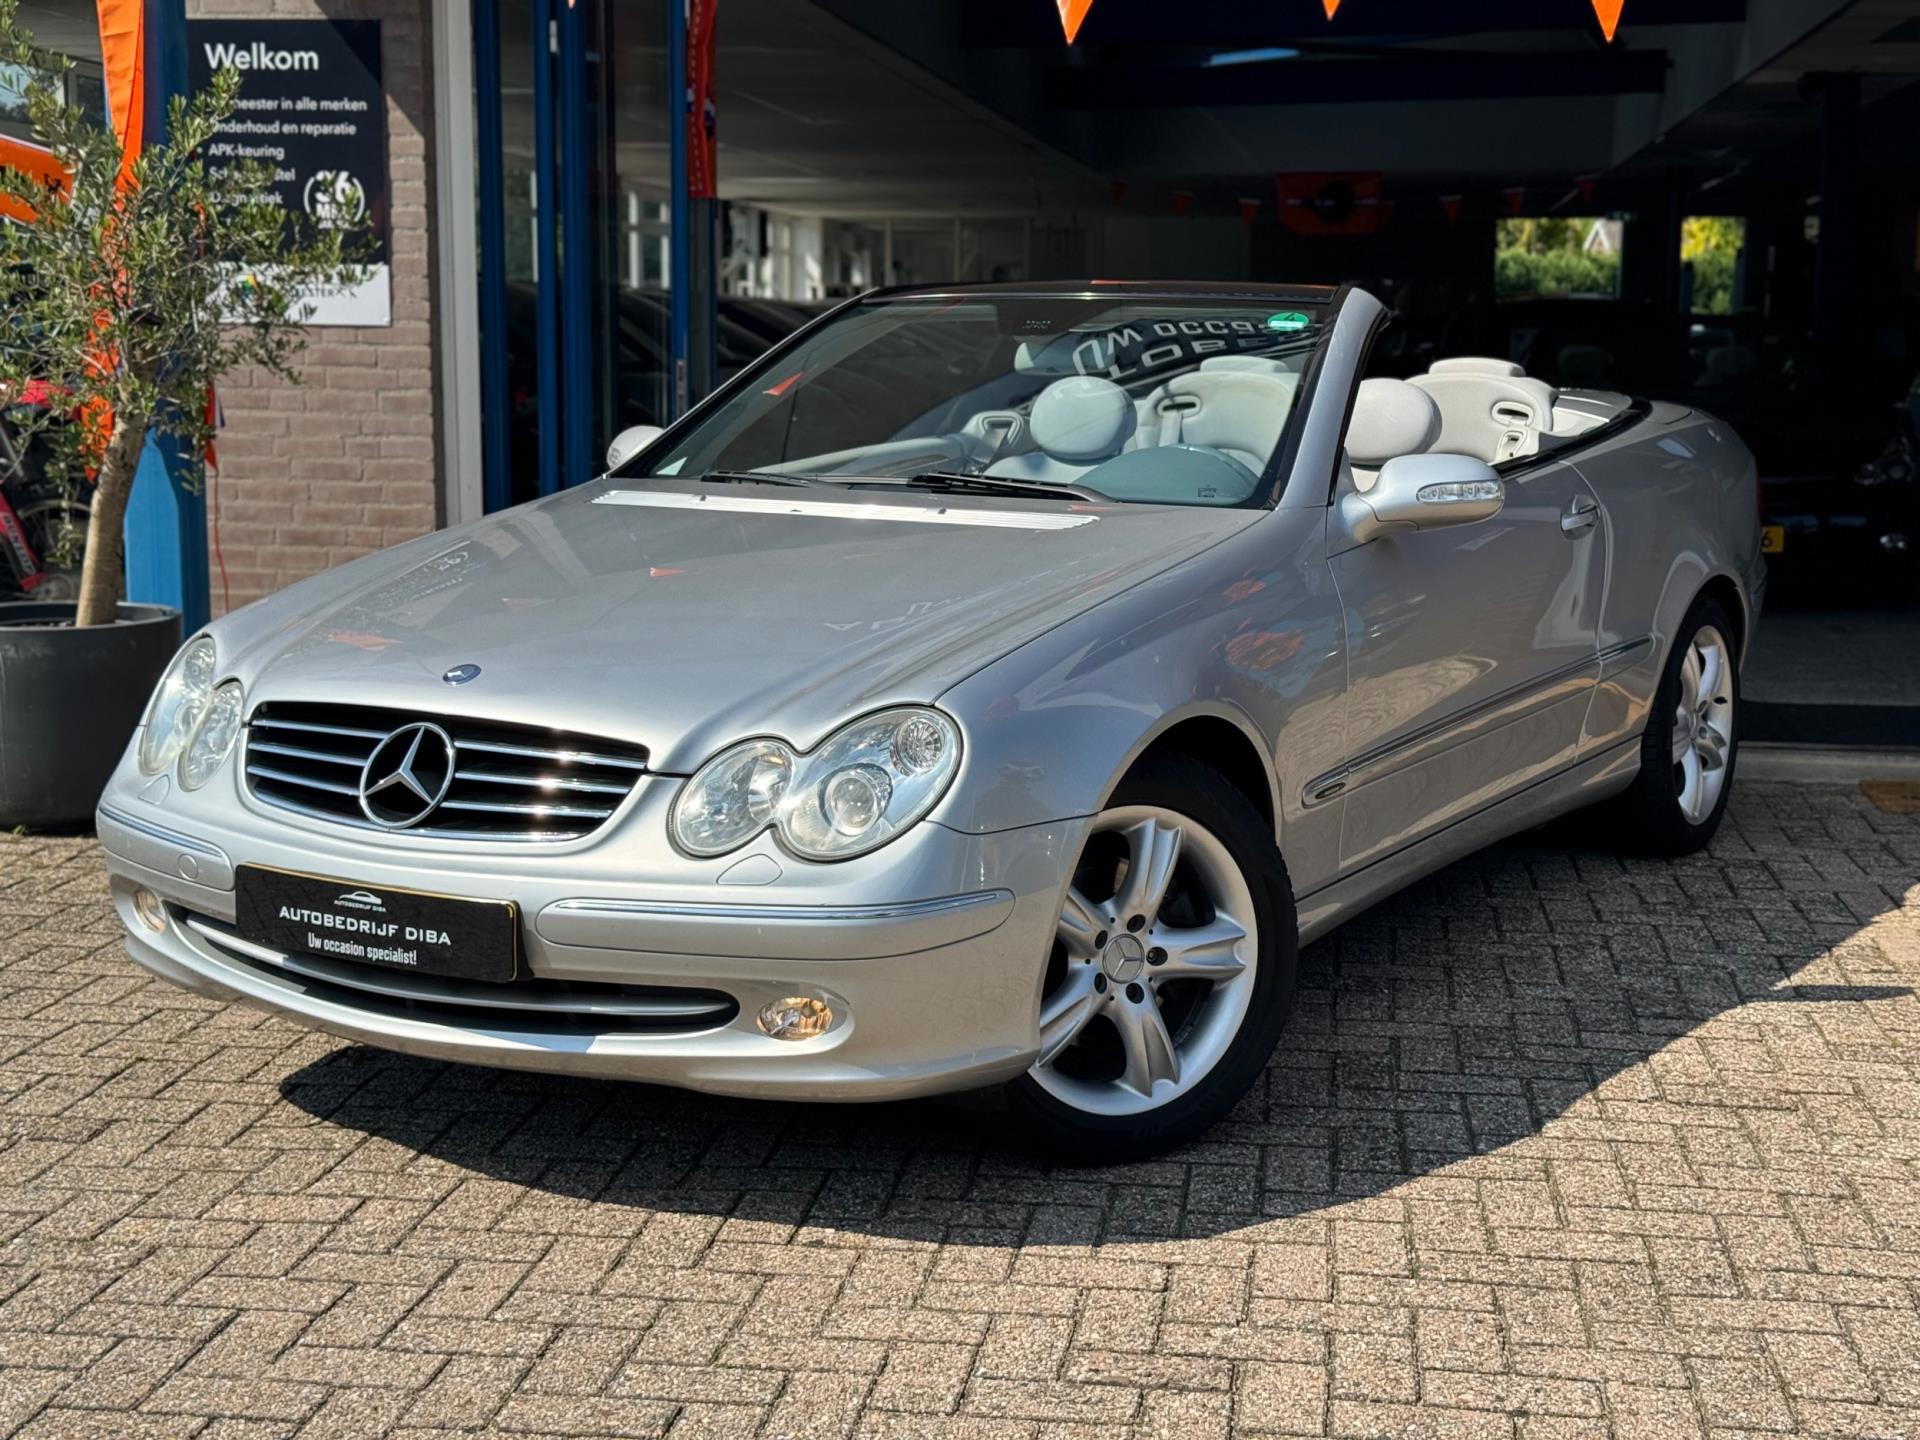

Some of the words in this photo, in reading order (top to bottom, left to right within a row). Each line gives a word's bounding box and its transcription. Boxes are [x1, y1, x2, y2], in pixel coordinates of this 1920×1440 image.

[204, 42, 319, 70] Welkom
[281, 97, 293, 110] in
[295, 97, 319, 111] alle
[320, 97, 368, 111] merken
[282, 124, 299, 135] en
[301, 122, 357, 138] reparatie
[208, 143, 286, 160] APK-keuring
[279, 905, 399, 938] AUTOBEDRIJF
[404, 926, 452, 946] DIBA
[308, 931, 322, 949] Uw
[323, 938, 365, 957] occasion
[366, 944, 418, 966] specialist!
